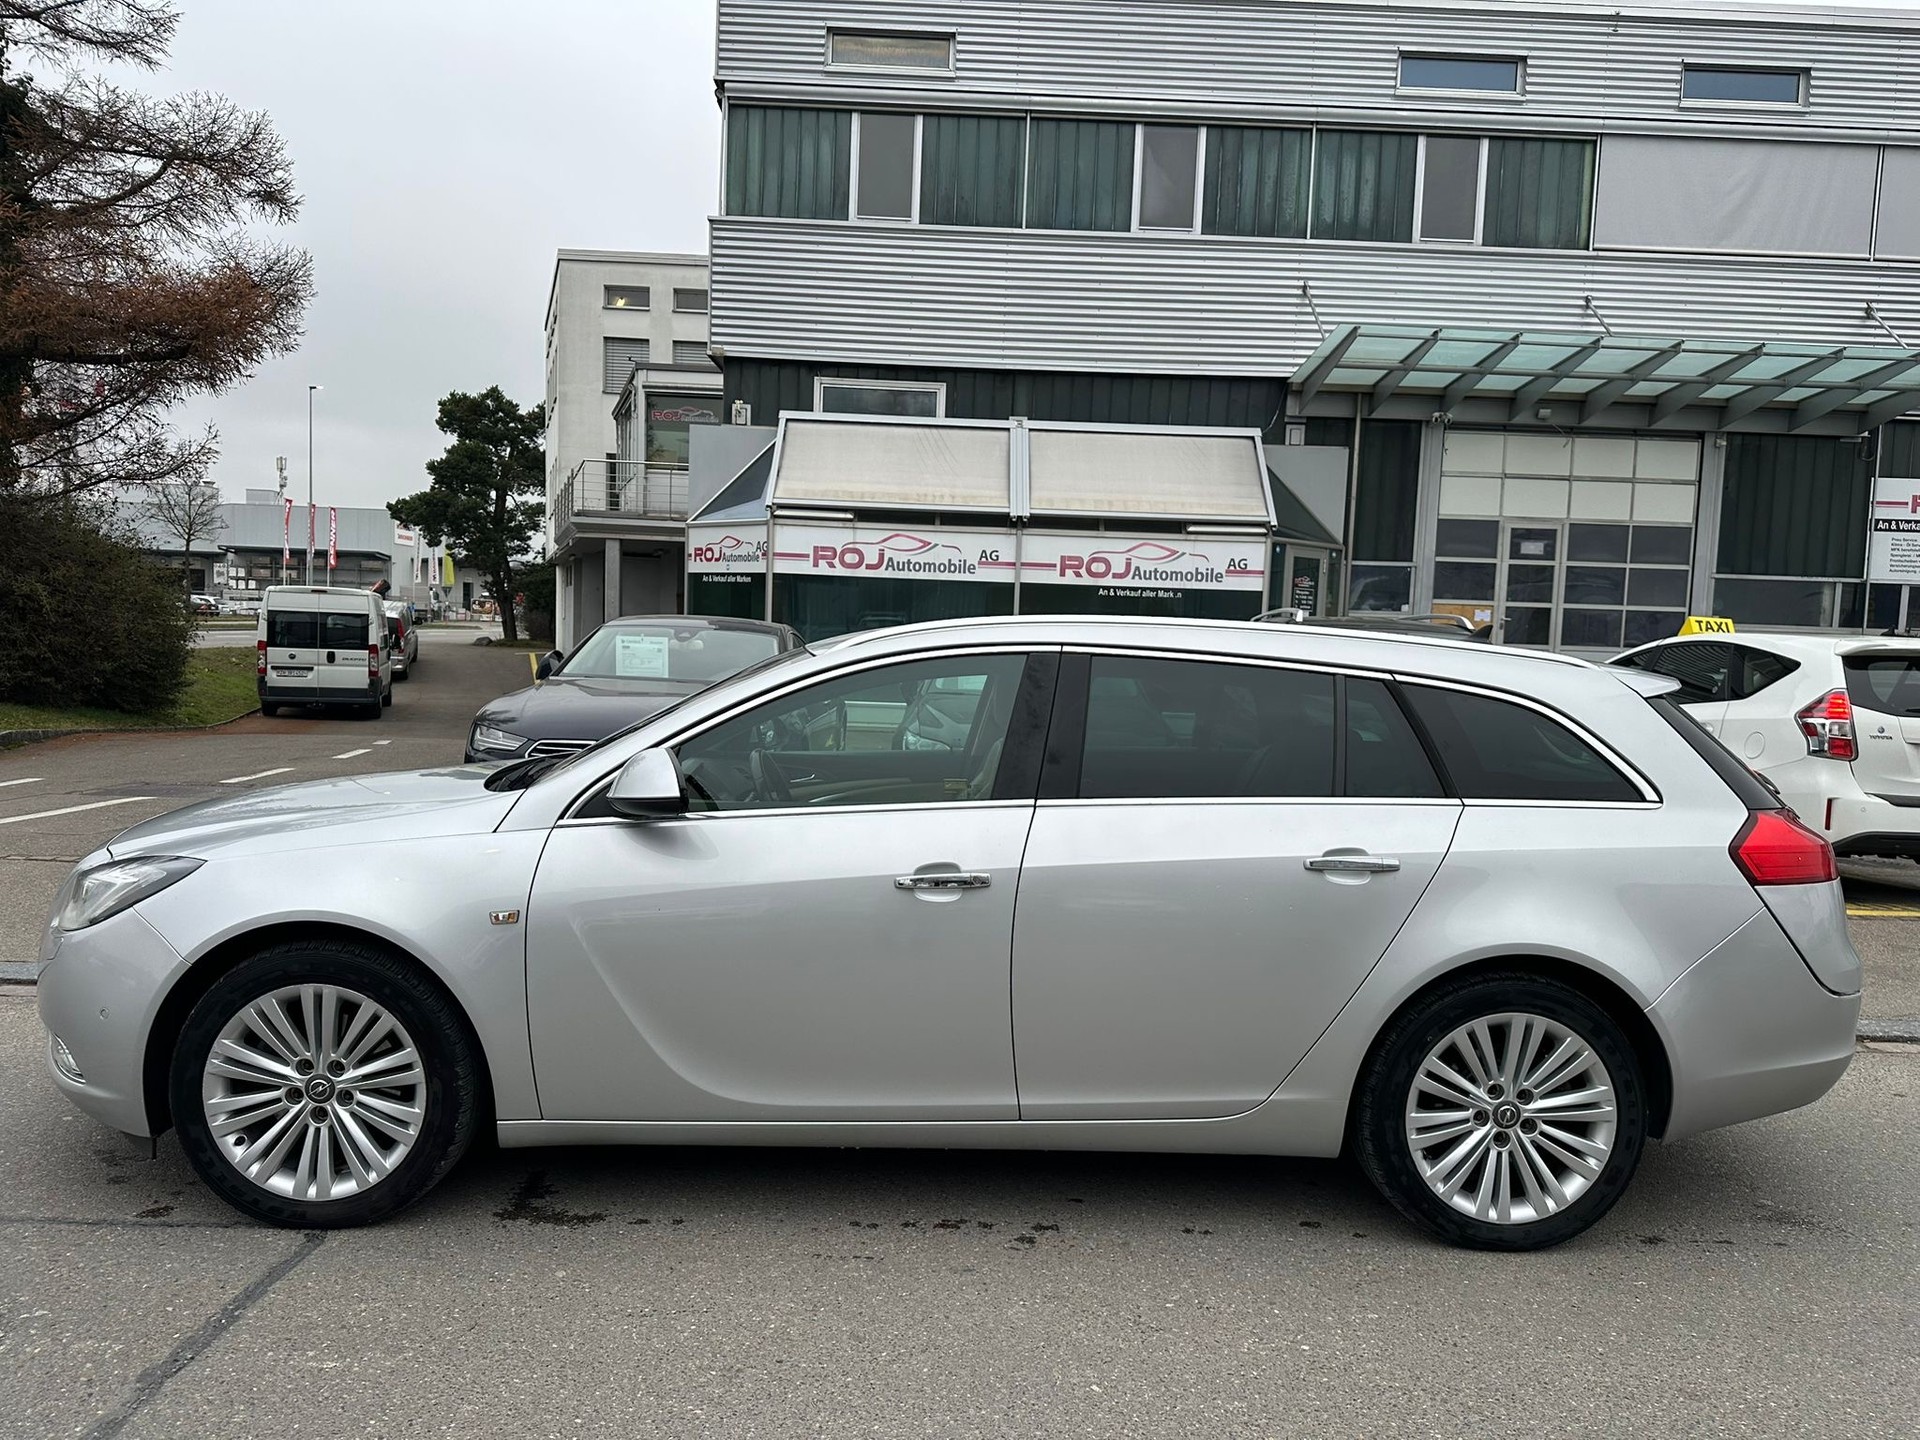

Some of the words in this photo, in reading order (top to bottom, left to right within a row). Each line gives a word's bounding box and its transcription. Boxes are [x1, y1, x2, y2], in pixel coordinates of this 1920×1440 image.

[1877, 520, 1889, 530] An
[1890, 520, 1897, 530] &
[694, 546, 722, 562] ROJ
[722, 552, 760, 563] Automobile
[812, 545, 885, 571] ROJ
[884, 557, 977, 575] Automobile
[979, 550, 1000, 562] AG
[1059, 555, 1132, 579] ROJ
[1131, 566, 1224, 583] Automobile
[1227, 558, 1248, 570] AG
[1116, 589, 1141, 597] Verkauf
[1142, 589, 1157, 597] aller
[1157, 590, 1182, 598] Markn
[1695, 620, 1730, 633] TAXI
